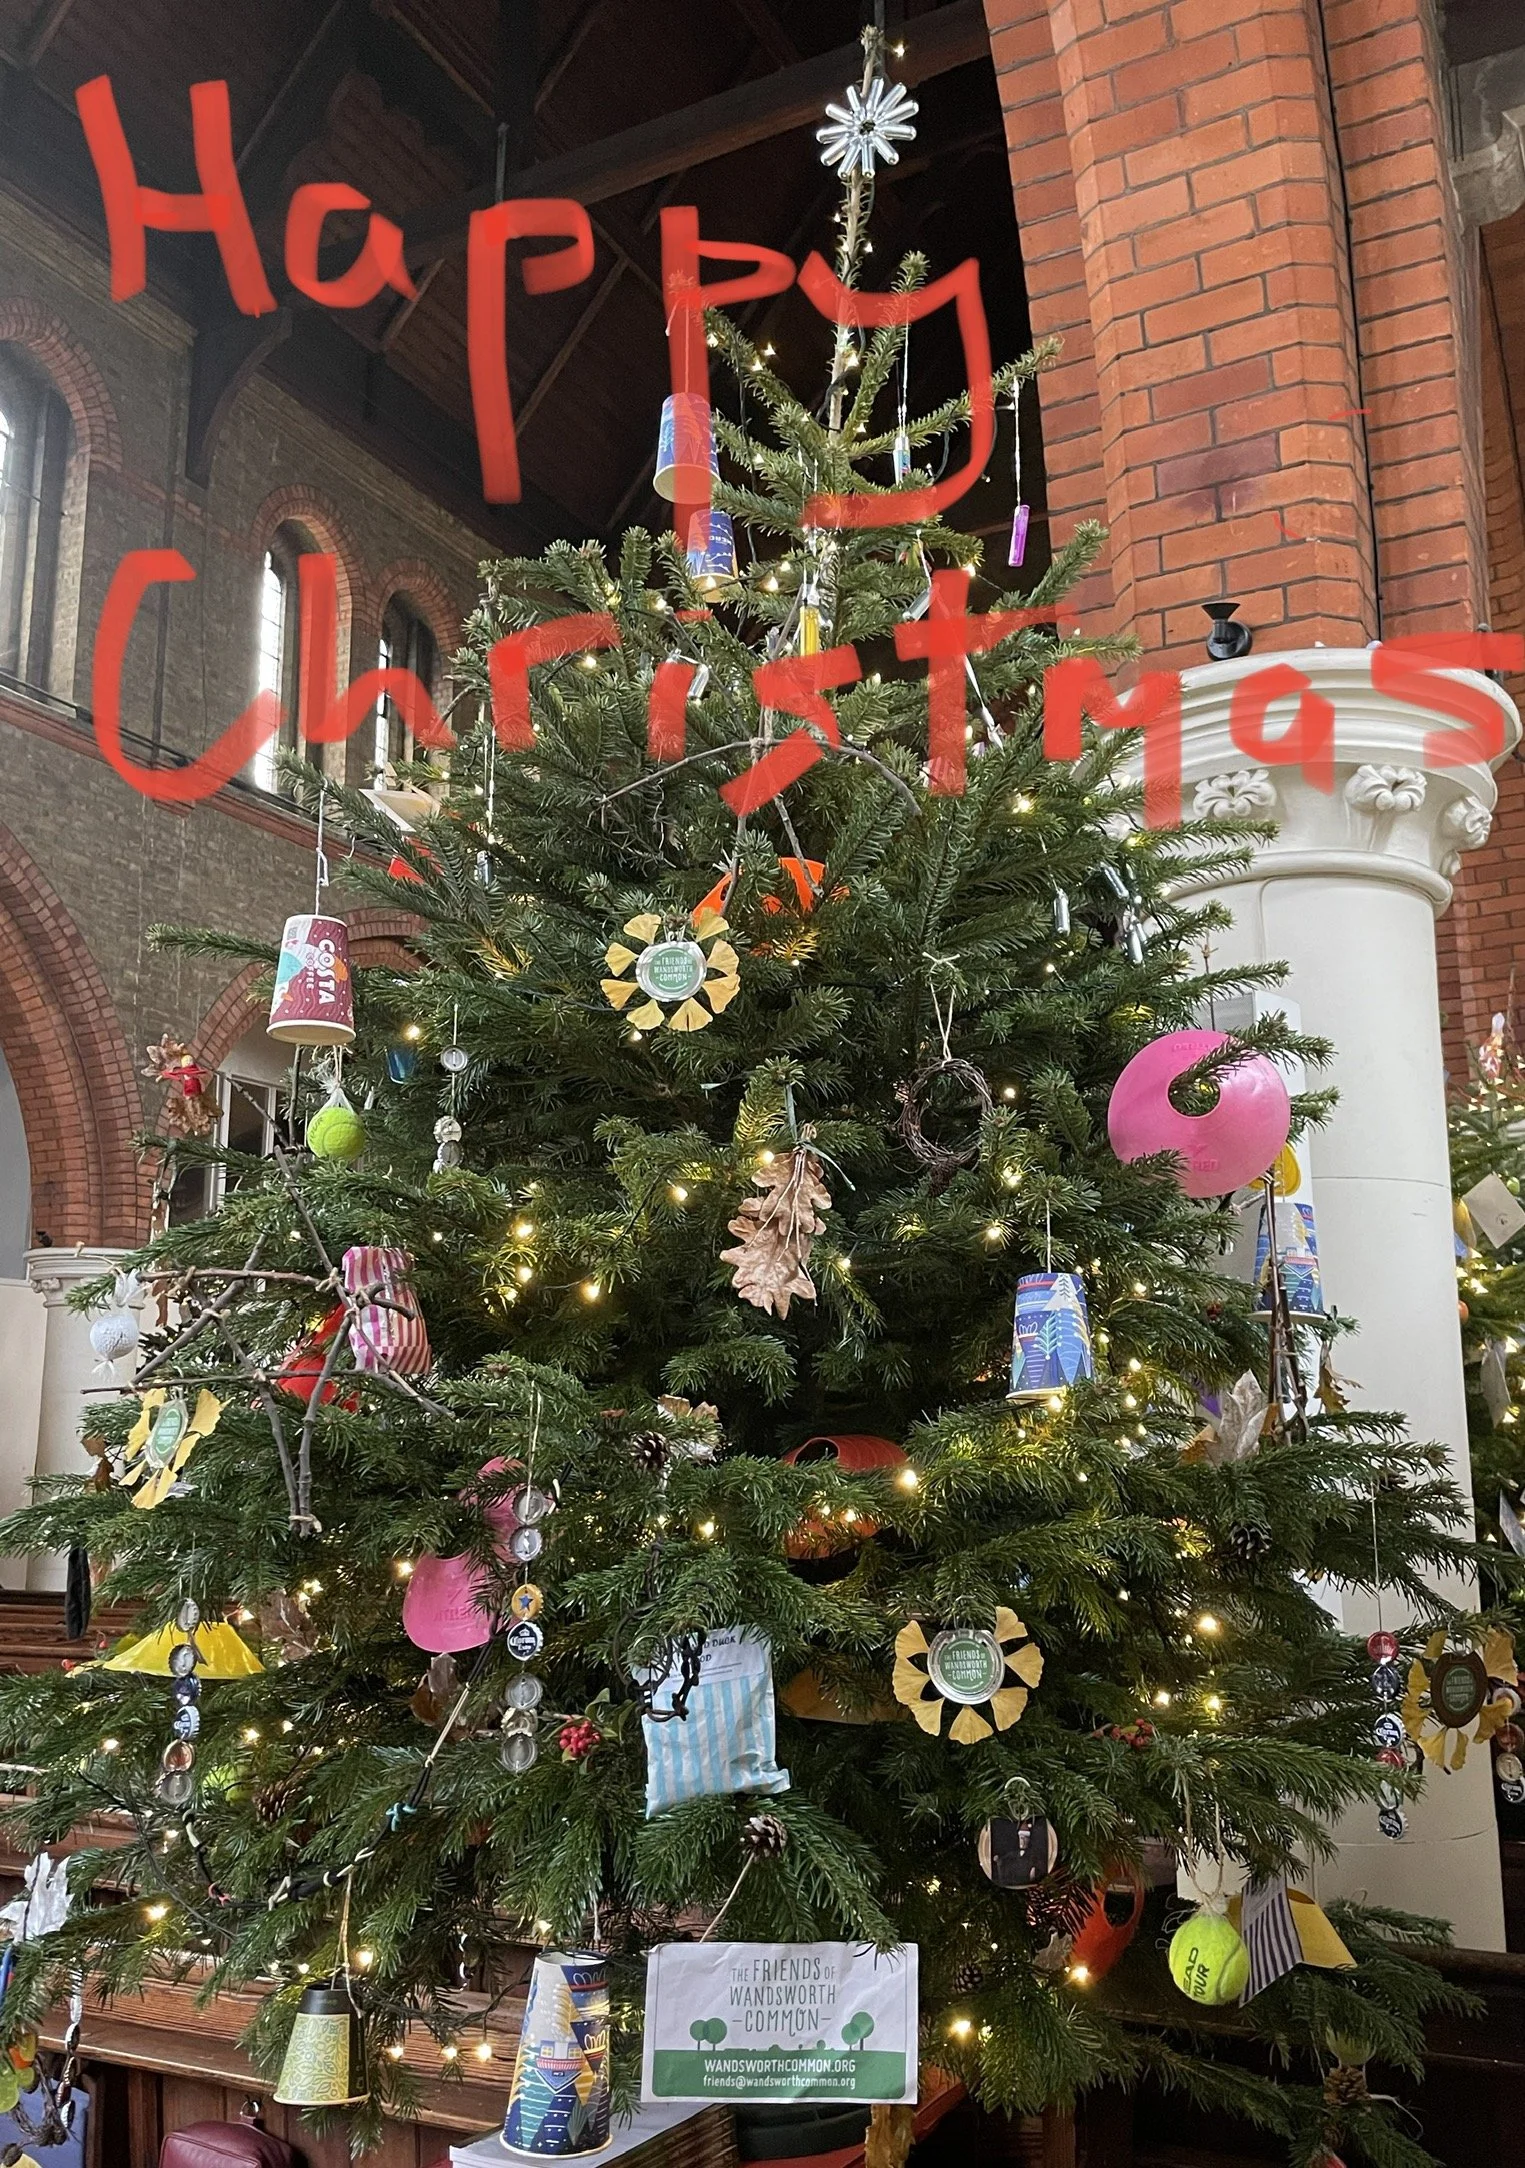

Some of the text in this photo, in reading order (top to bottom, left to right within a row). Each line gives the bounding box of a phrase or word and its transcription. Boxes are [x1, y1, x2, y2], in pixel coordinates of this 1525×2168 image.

[306, 952, 315, 990] COFFEE
[316, 939, 336, 1005] COSTA
[659, 973, 688, 983] COMMON
[711, 1635, 737, 1648] DUCK
[952, 1649, 980, 1660] FRIENDS
[951, 1669, 983, 1681] COMMON
[731, 1957, 836, 1982] THE FRIENDS OF
[1182, 1947, 1199, 1994] EAD
[1193, 1963, 1210, 2000] TOUR
[730, 1984, 836, 2007] WANDSWORTH
[745, 2008, 820, 2037] COMMON
[704, 2058, 856, 2073] WANDSWORTHCOMMON.ORG
[703, 2075, 856, 2090] friends@wandsworthcommon.org
